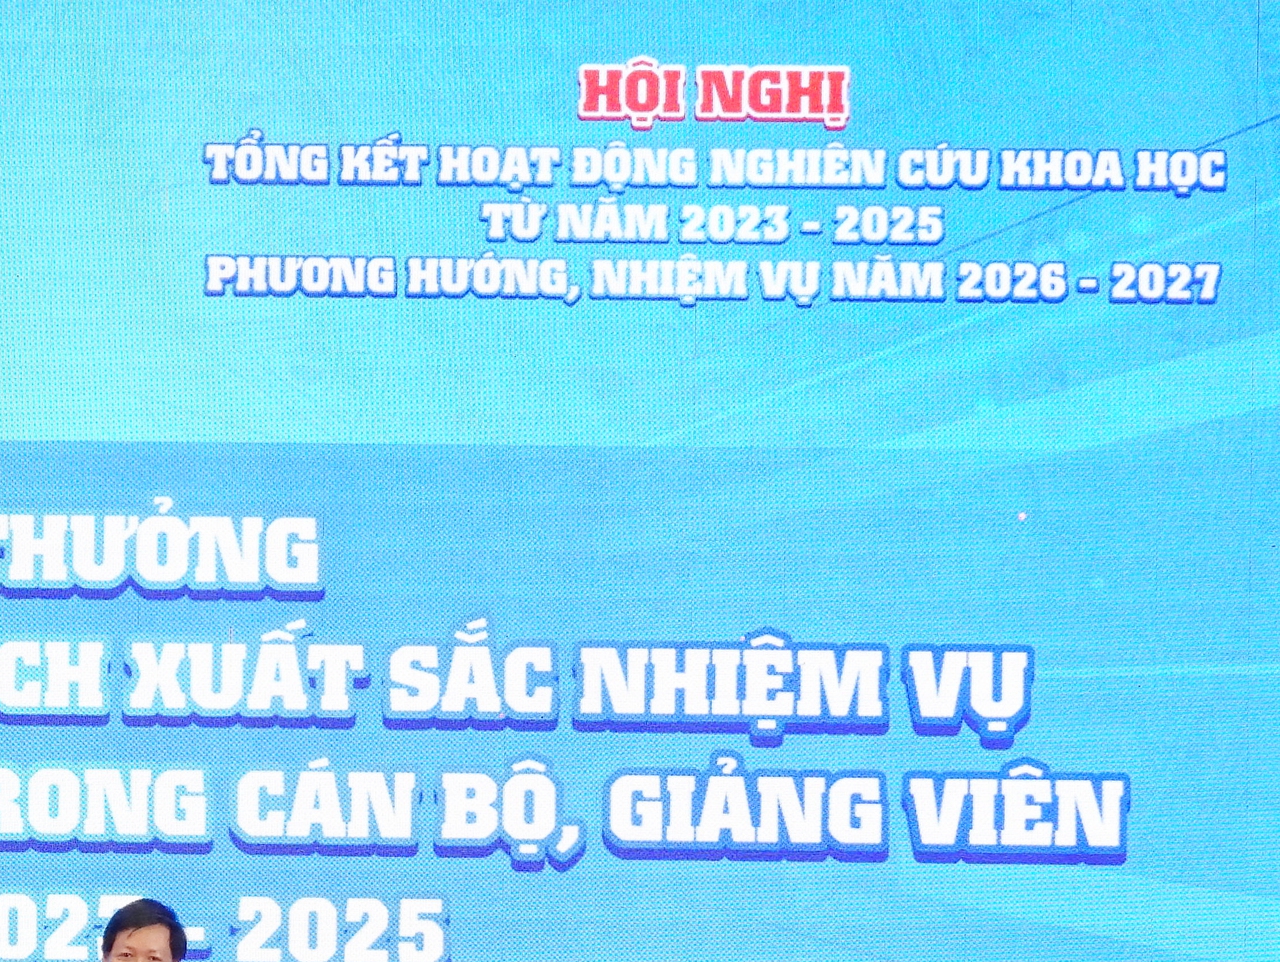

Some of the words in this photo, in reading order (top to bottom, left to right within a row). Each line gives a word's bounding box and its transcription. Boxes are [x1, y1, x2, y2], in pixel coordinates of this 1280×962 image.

[581, 58, 684, 127] HỘI
[698, 66, 847, 127] NGHỊ
[206, 131, 327, 180] TỔNG
[341, 133, 427, 181] KẾT
[439, 147, 559, 190] HOẠT
[573, 141, 696, 191] ĐỘNG
[711, 143, 885, 184] NGHIÊN
[899, 143, 989, 185] CỨU
[1001, 150, 1123, 186] KHOA
[1137, 151, 1224, 194] HỌC
[483, 196, 546, 239] TỪ
[558, 197, 667, 240] NĂM
[681, 206, 788, 240] 2023
[802, 221, 820, 230] -
[836, 207, 942, 242] 2025
[207, 256, 394, 292] PHƯƠNG
[408, 252, 579, 302] HƯỚNG,
[593, 253, 747, 303] NHIỆM
[759, 261, 820, 304] VỤ
[833, 254, 943, 297] NĂM
[959, 262, 1065, 297] 2026
[1079, 279, 1097, 288] -
[1113, 264, 1219, 299] 2027
[129, 618, 364, 711] XUẤT
[389, 618, 553, 713] SẮC
[580, 635, 882, 729] NHIỆM
[909, 651, 1027, 731] VỤ
[236, 757, 416, 838] CÁN
[441, 759, 581, 854] BỘ,
[609, 757, 882, 844] GIẢNG
[910, 762, 1123, 848] VIÊN
